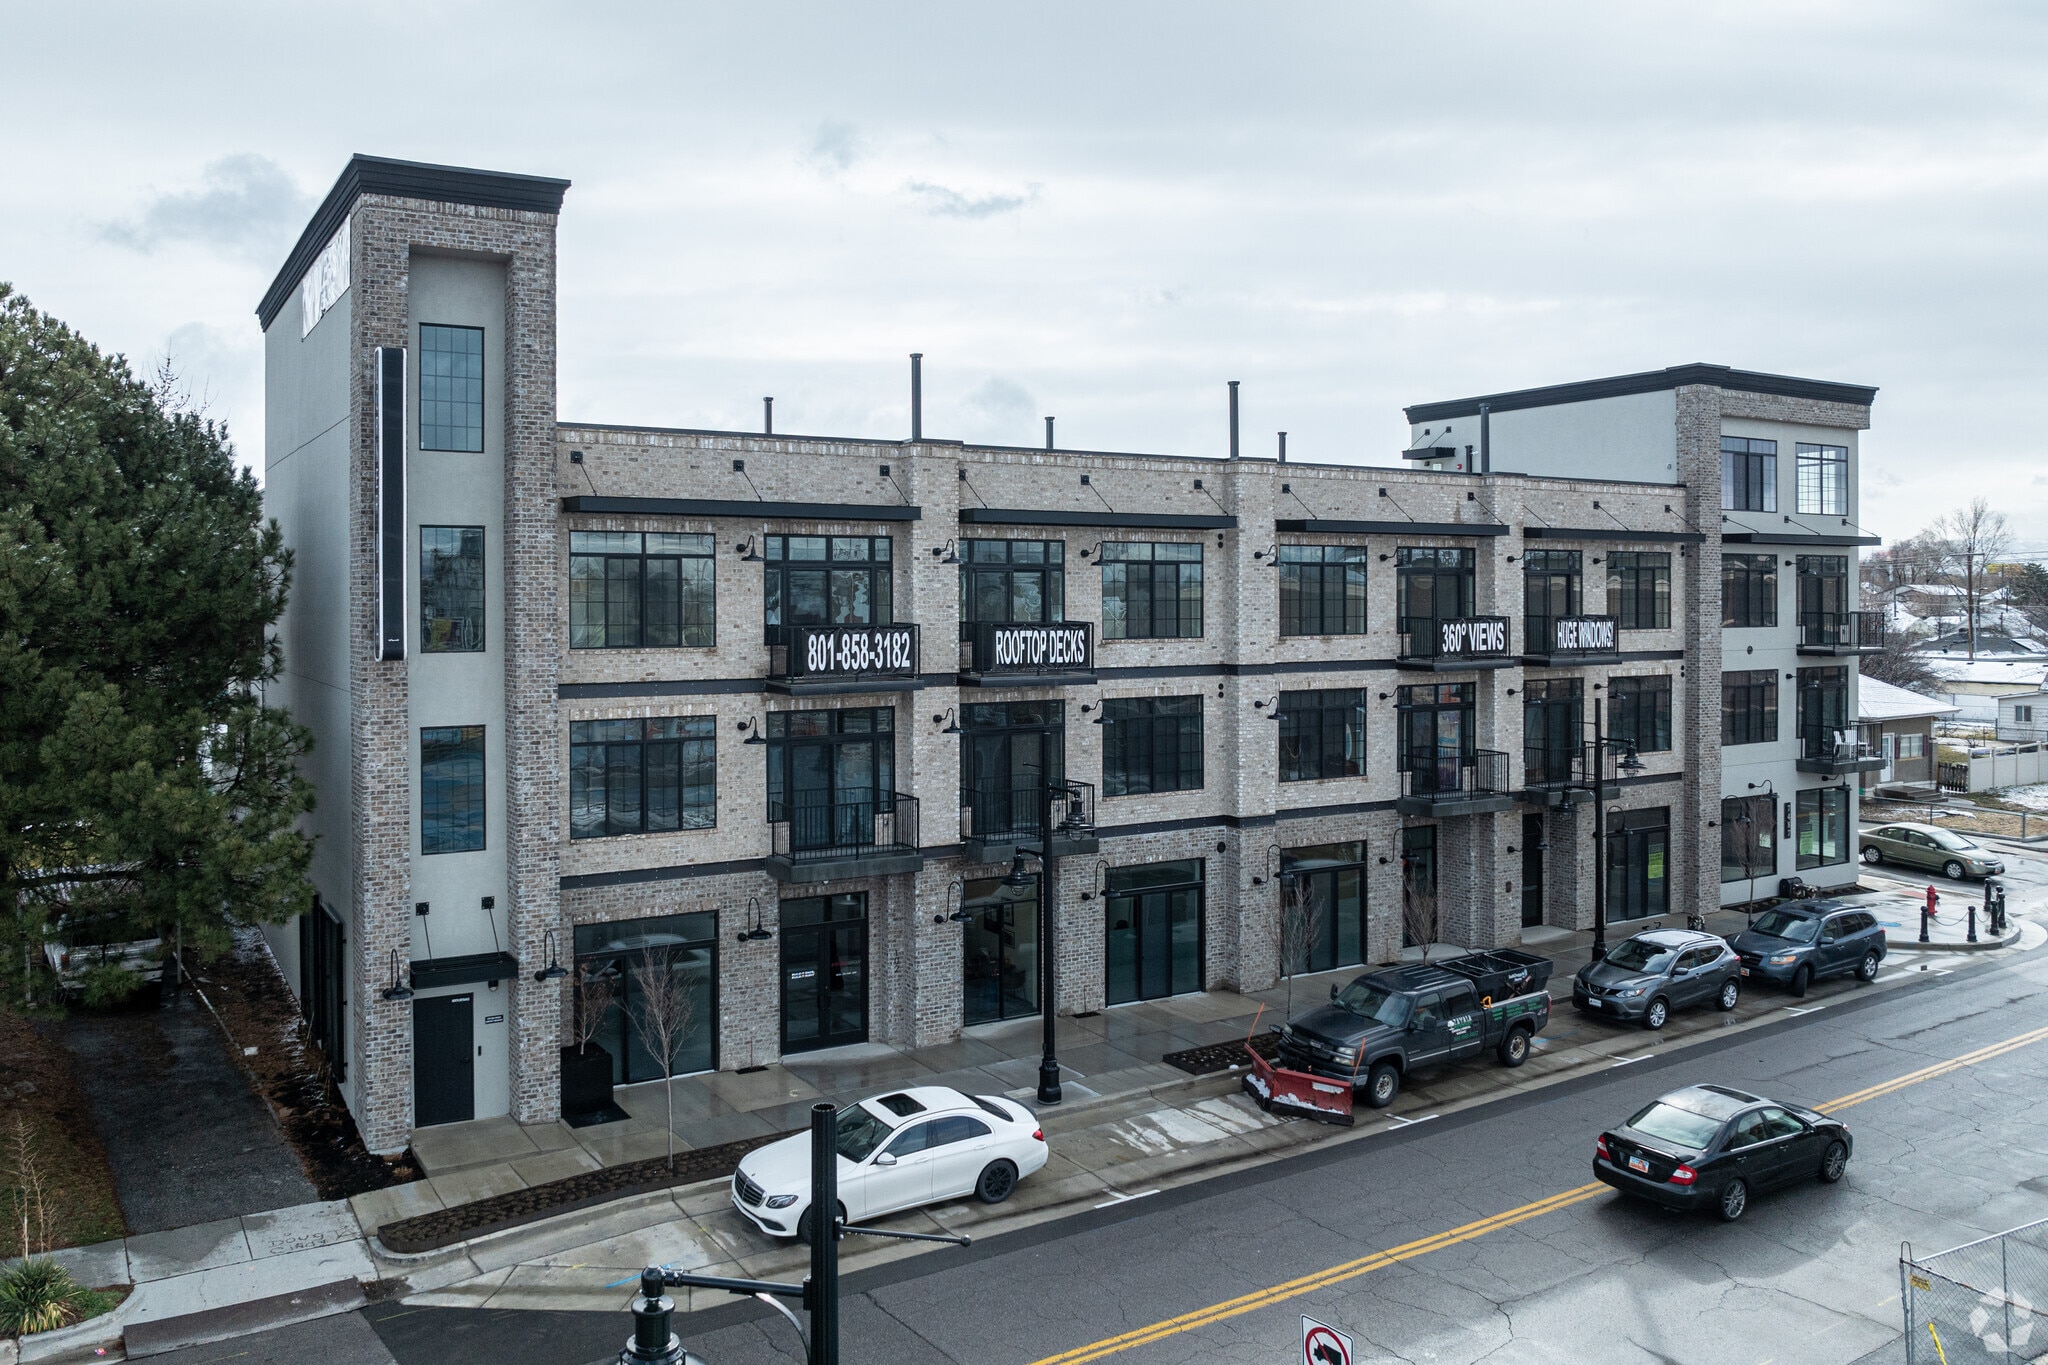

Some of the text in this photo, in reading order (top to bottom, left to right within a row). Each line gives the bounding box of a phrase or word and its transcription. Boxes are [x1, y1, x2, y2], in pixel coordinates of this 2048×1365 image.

[807, 631, 910, 672] 801-858-3182
[995, 629, 1085, 665] ROOFTOP DECKS
[1468, 622, 1504, 652] VIEWS
[1557, 622, 1577, 649] HUGE
